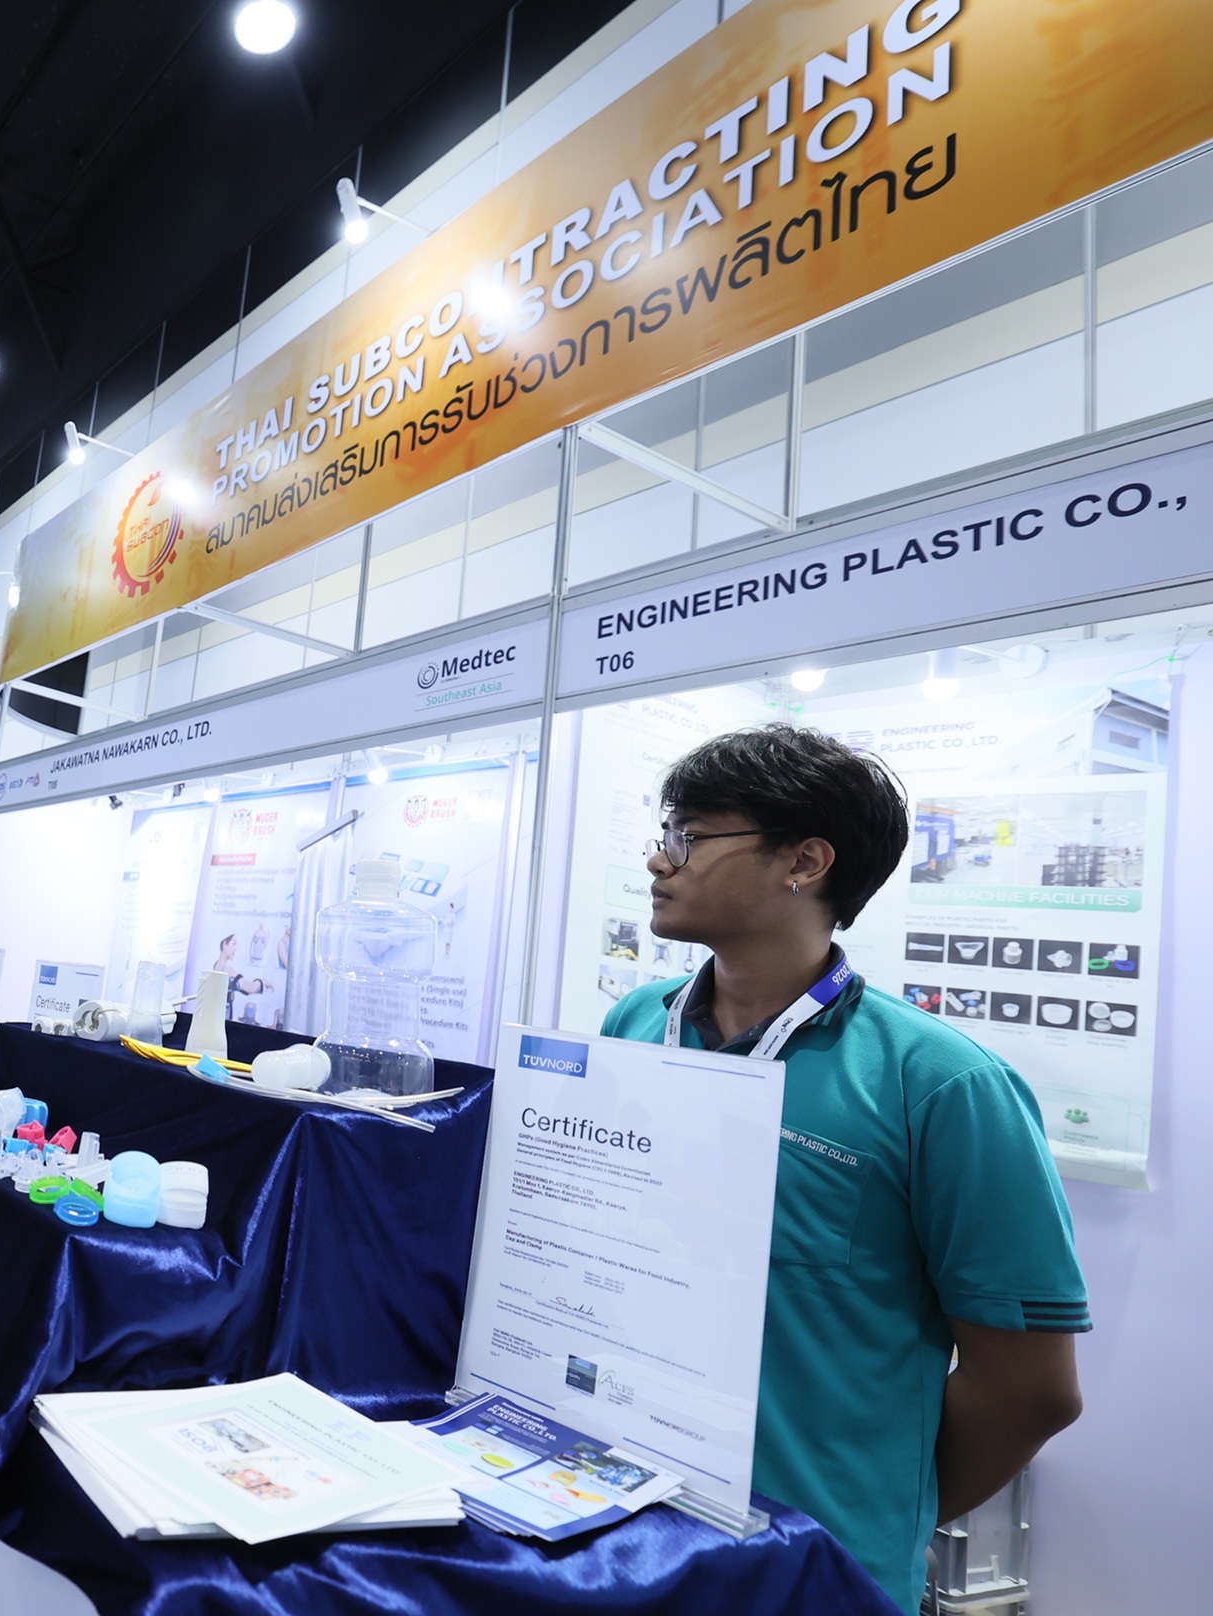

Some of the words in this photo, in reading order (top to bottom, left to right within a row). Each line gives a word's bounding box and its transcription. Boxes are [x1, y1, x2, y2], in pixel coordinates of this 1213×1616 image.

[216, 396, 294, 470] THAI
[306, 0, 961, 415] SUBCONTRACTING
[211, 355, 426, 507] PROMOTION
[438, 41, 952, 379] ASSOCIATION
[205, 133, 957, 554] สมาคมส่งเสริมการรับช่วงการผลิตไทย
[596, 562, 828, 639] ENGINEERING
[843, 507, 1045, 583] PLASTIC
[1064, 480, 1188, 530] CO.,
[441, 646, 516, 678] Medtec
[595, 650, 635, 675] T06
[426, 687, 477, 706] Southeast
[479, 681, 502, 694] Asia
[882, 721, 976, 738] ENGINEERING
[50, 751, 100, 773] JAKAWATNA
[101, 735, 158, 762] NAWAKARN
[161, 729, 184, 748] CO.,
[187, 720, 212, 741] LTD.
[880, 740, 937, 753] PLASTIC
[916, 887, 950, 900] OUR
[1029, 892, 1131, 907] FACILITIES
[36, 995, 70, 1013] Certificate
[523, 1055, 583, 1074] TÜVNORD
[521, 1107, 652, 1153] Certificate
[518, 1132, 533, 1140] GHPs
[534, 1135, 551, 1145] (Good
[551, 1140, 576, 1151] Hygiene
[576, 1145, 608, 1158] Practices)
[797, 1135, 828, 1154] PLASTIC
[513, 1171, 547, 1183] ENGINEERING
[548, 1179, 570, 1189] PLASTIC
[511, 1189, 532, 1198] Thailand
[525, 1241, 542, 1250] Clamp
[505, 1229, 543, 1243] Manufacturing
[549, 1241, 567, 1250] Plastic
[567, 1247, 594, 1258] Container
[598, 1257, 618, 1266] Plastic
[618, 1263, 637, 1272] Wares
[647, 1271, 662, 1279] Food
[664, 1276, 692, 1290] Industry,
[487, 1408, 522, 1426] PLASTIC
[492, 1405, 548, 1431] ENGINEERING
